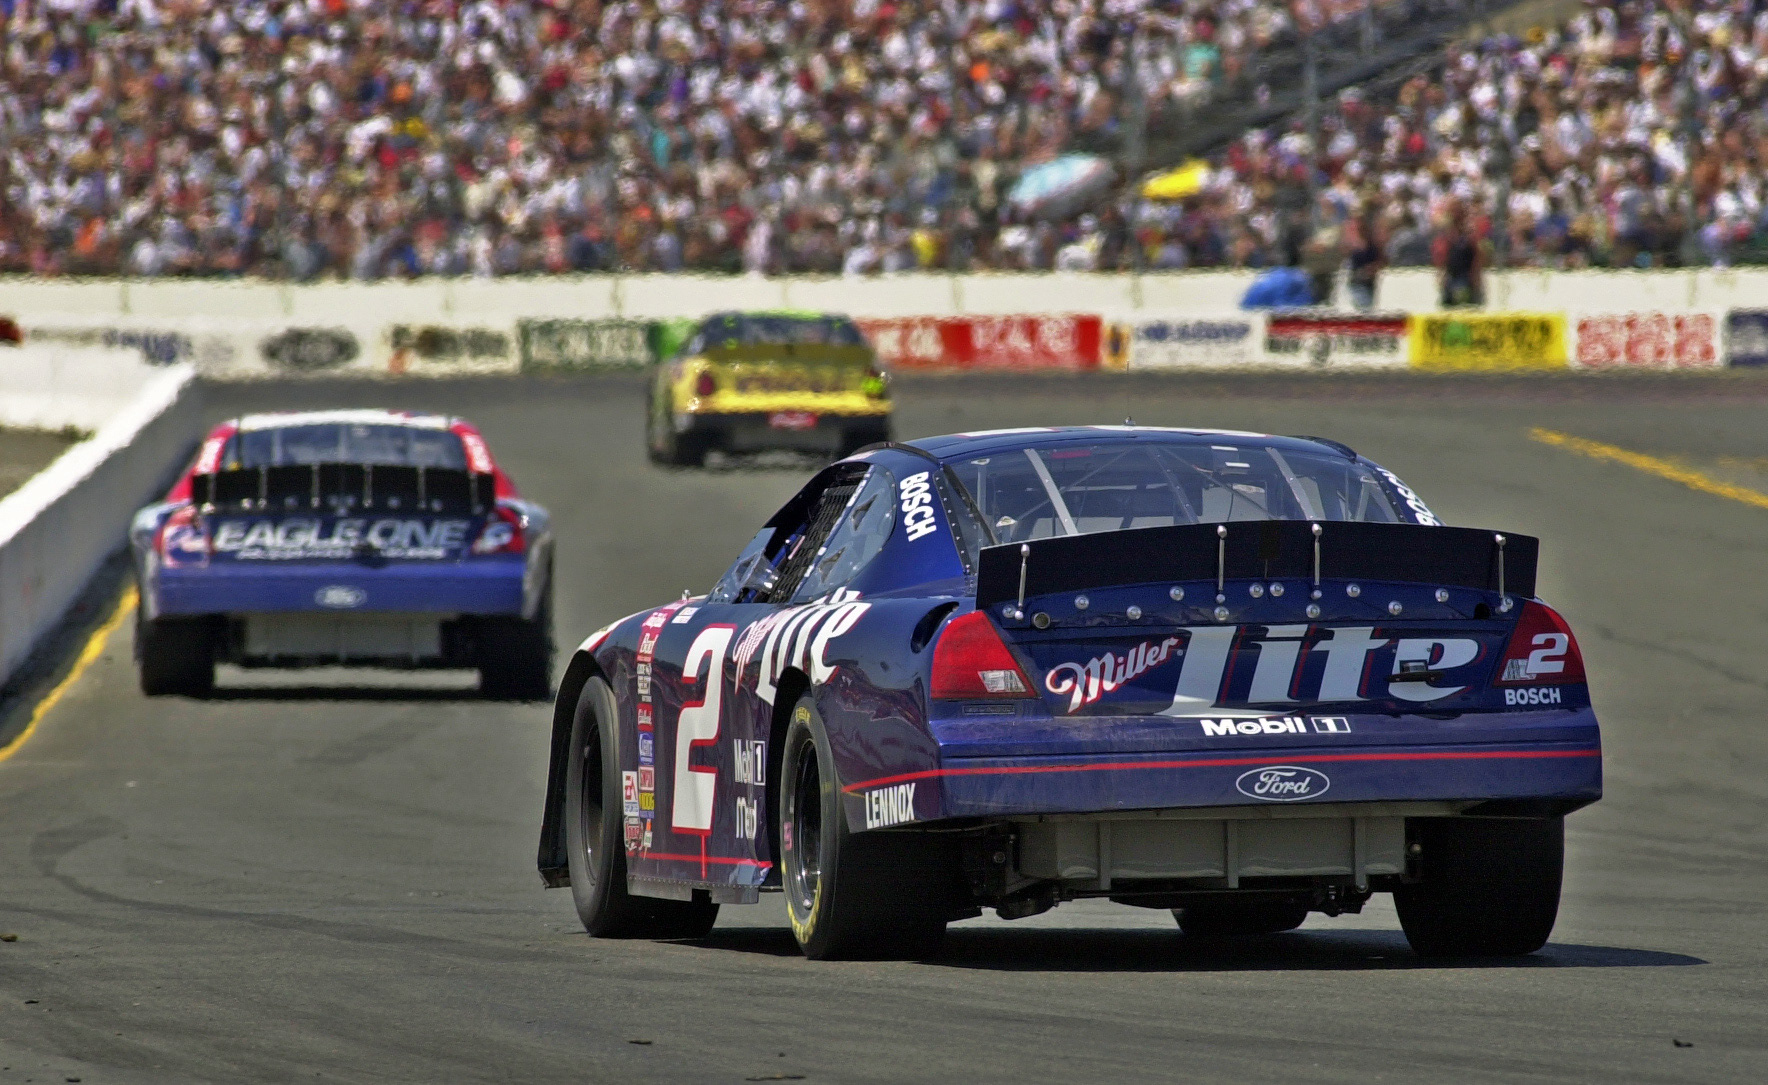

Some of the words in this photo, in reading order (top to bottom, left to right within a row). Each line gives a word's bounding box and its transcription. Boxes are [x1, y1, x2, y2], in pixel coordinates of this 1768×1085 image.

[900, 471, 937, 542] BOSCH
[213, 519, 364, 552] EAGLE
[367, 518, 470, 550] ONE
[1525, 632, 1569, 674] 2
[1045, 636, 1183, 715] Miller
[1504, 687, 1562, 706] BOSCH
[670, 622, 737, 834] 2
[1200, 717, 1306, 737] Mobil
[1253, 768, 1311, 796] Ford
[864, 782, 916, 830] LENNOX
